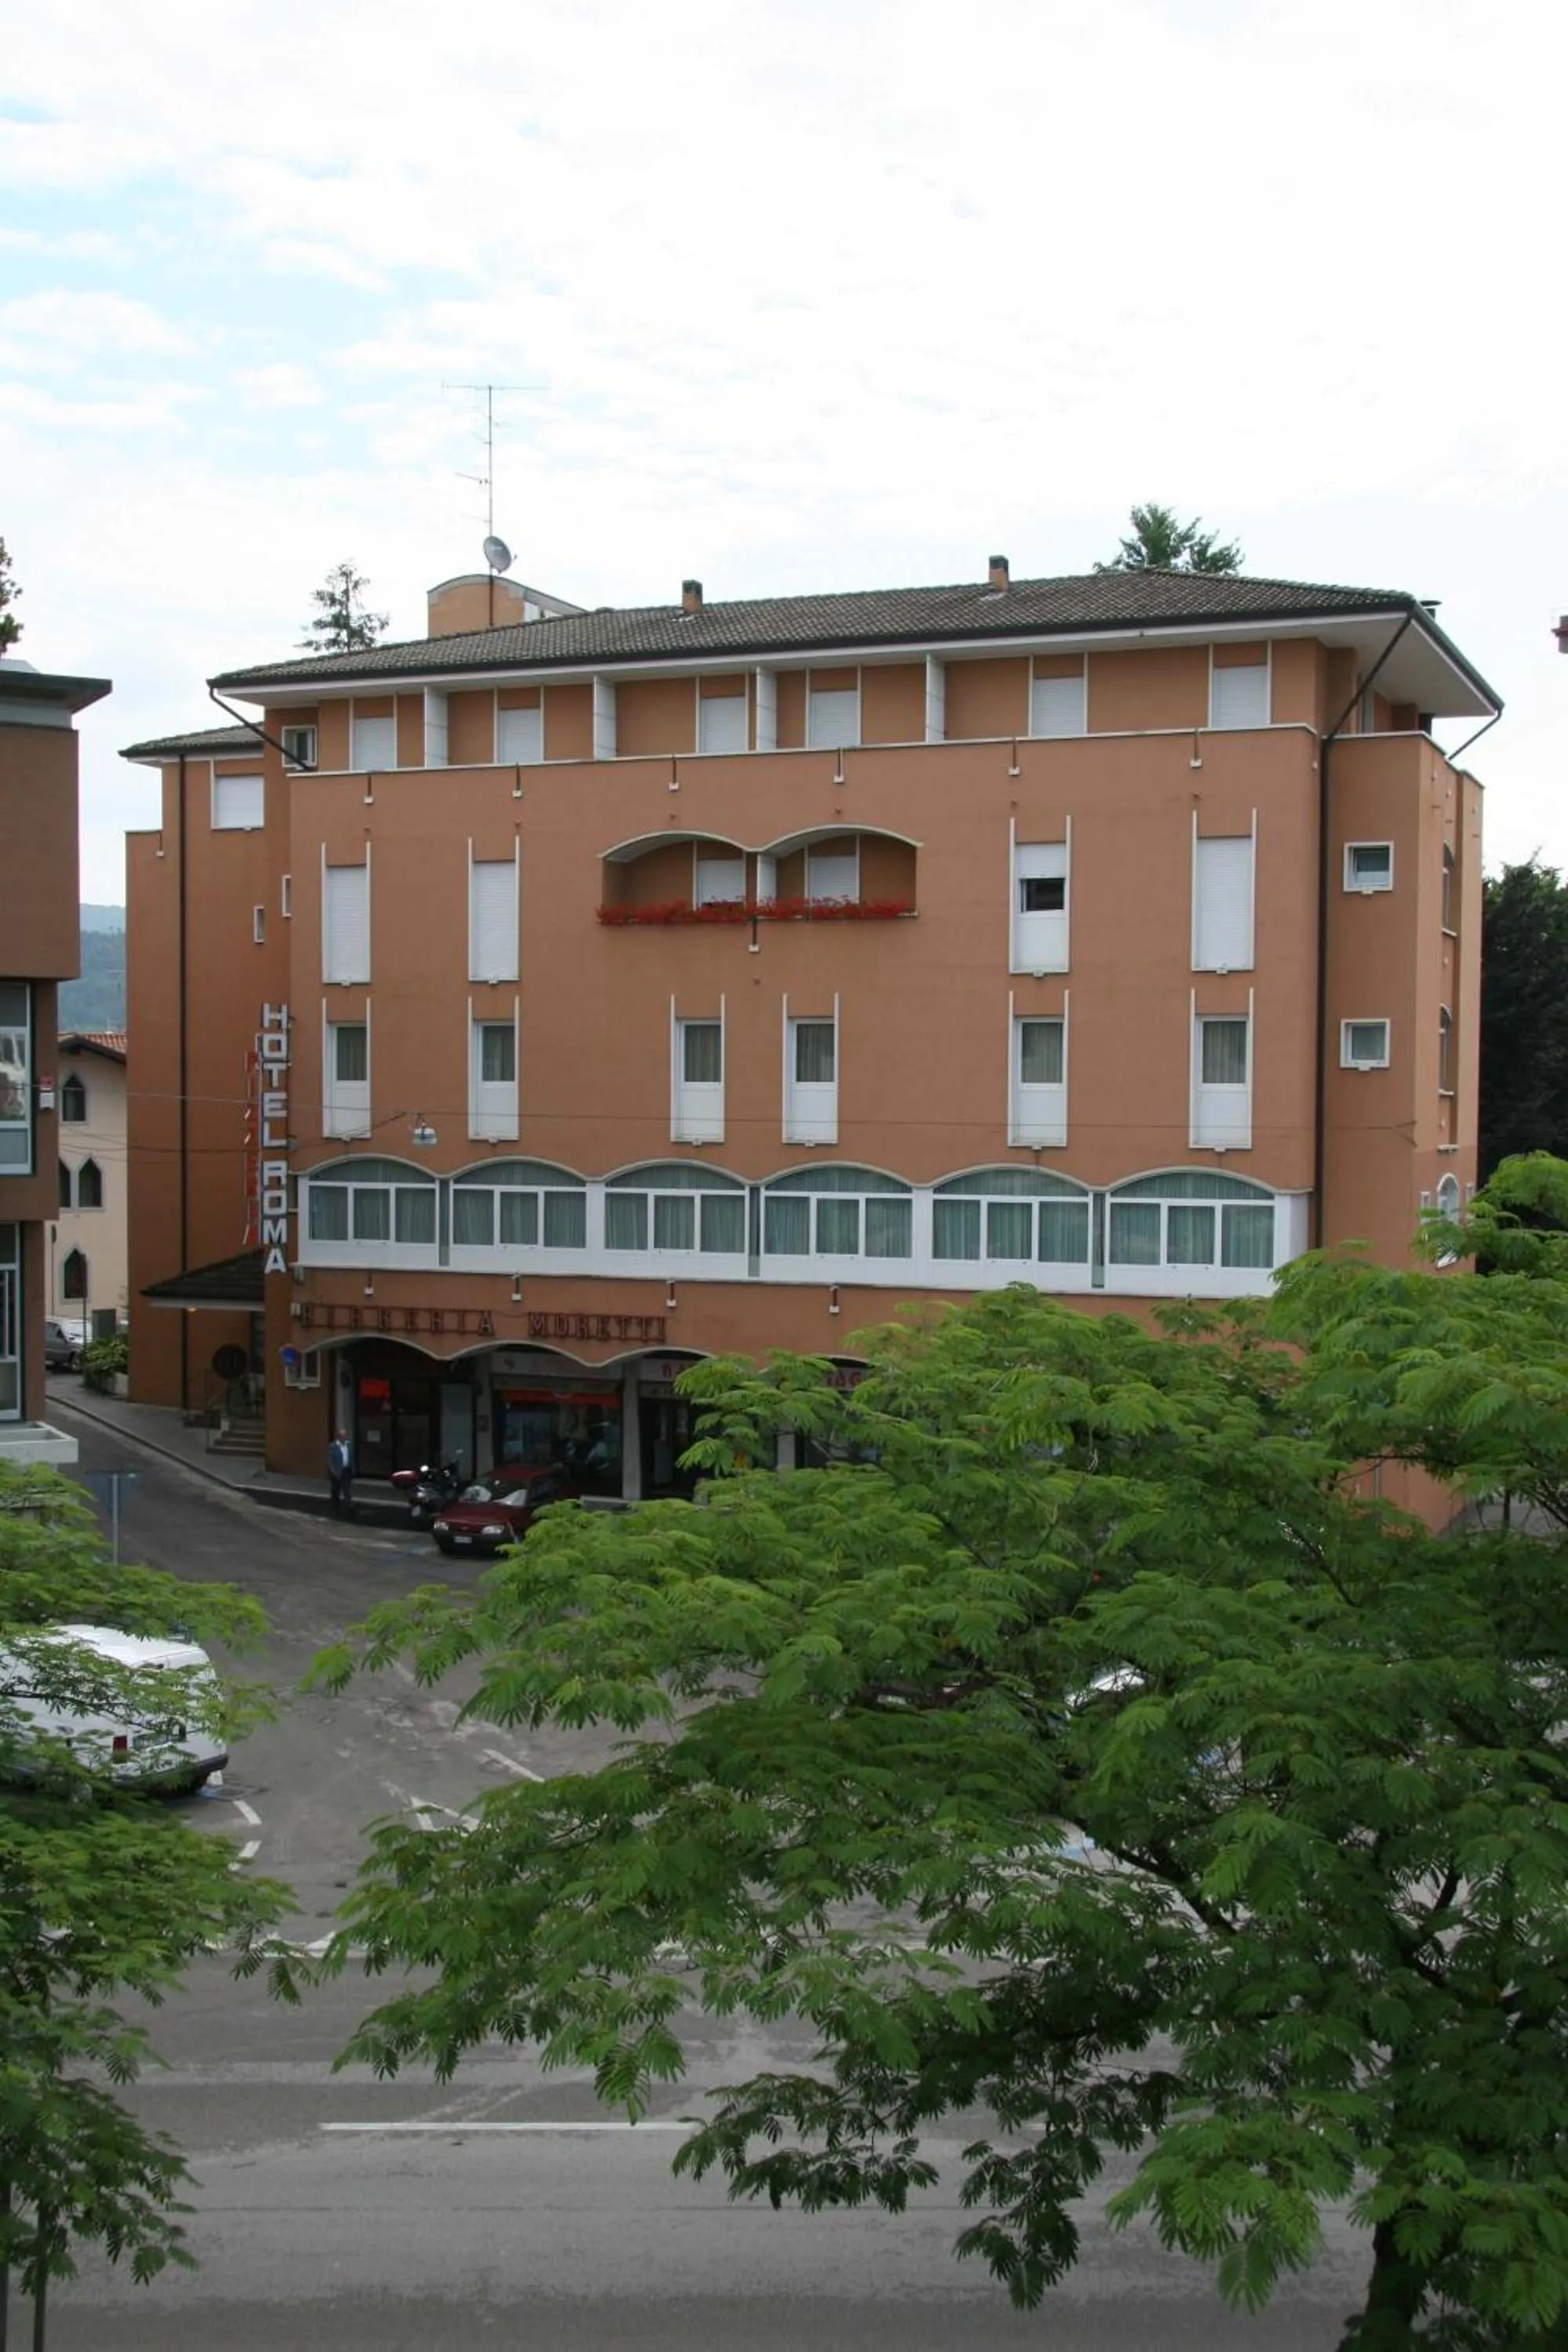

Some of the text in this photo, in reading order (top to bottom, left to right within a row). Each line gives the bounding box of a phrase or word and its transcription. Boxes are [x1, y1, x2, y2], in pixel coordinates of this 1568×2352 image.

[262, 1003, 289, 1274] HOTEL ROMA
[528, 1312, 666, 1343] MORETTI
